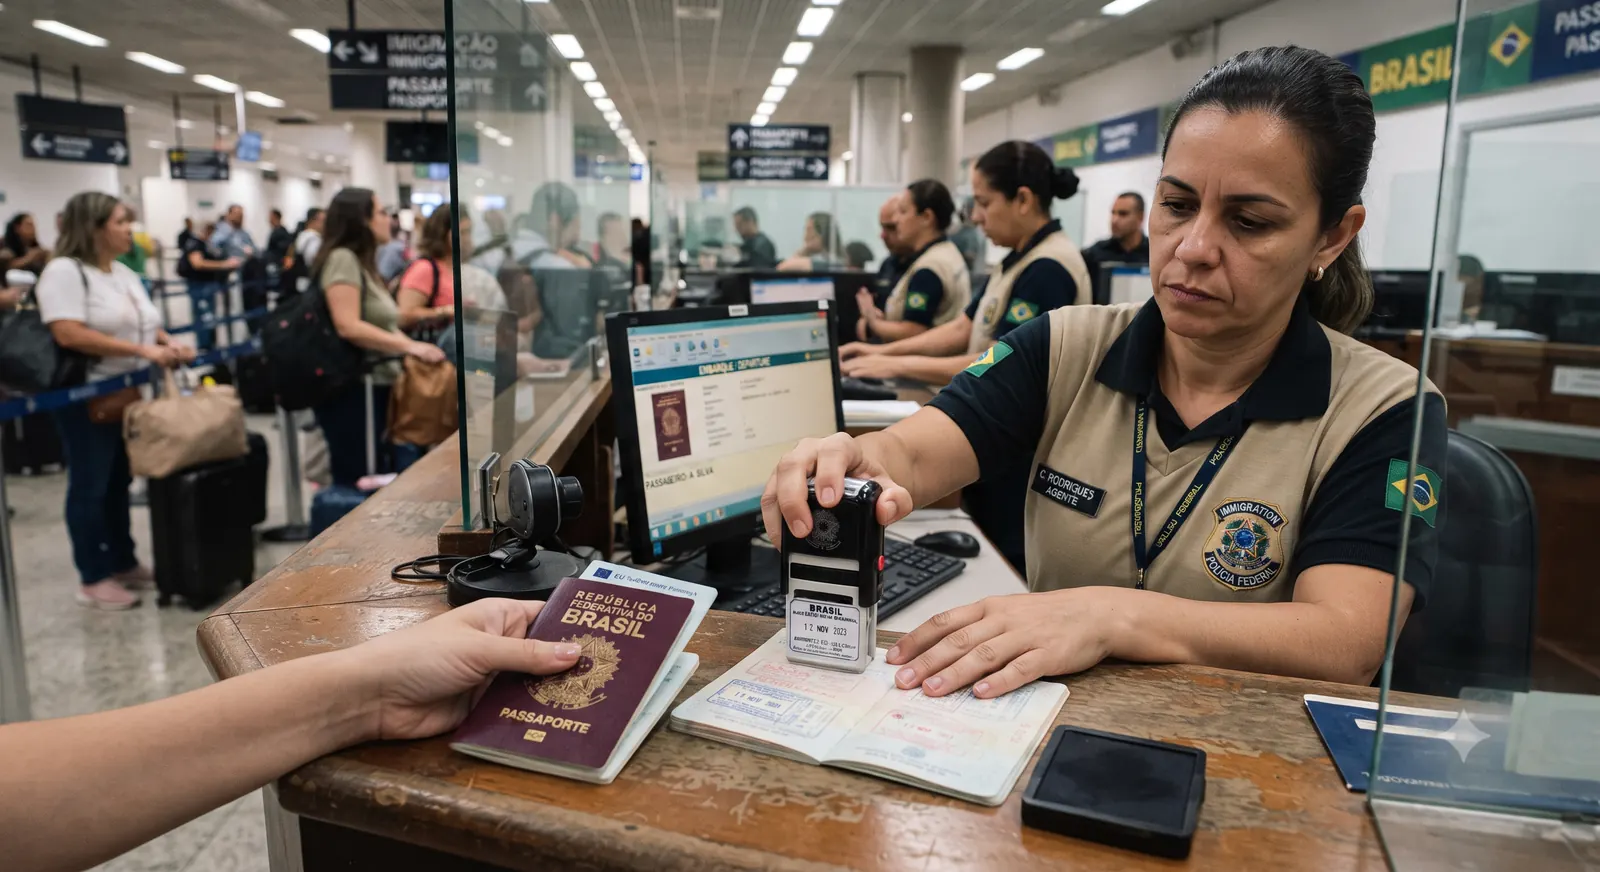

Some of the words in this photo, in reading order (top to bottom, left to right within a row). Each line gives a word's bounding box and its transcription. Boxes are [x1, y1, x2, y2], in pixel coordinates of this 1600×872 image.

[1369, 45, 1453, 95] BRASIL
[1045, 486, 1079, 507] AGENTE
[1047, 472, 1095, 501] RODRIGUES
[1219, 502, 1281, 525] IMMIGRATION
[1237, 567, 1278, 586] FEDERAL
[569, 599, 634, 619] FEDERATIVA
[635, 611, 654, 622] DO
[575, 590, 657, 614] REPÚBLICA
[809, 603, 843, 616] BRASIL
[560, 607, 645, 639] BRASIL
[816, 625, 829, 634] NOV
[833, 627, 848, 636] 2023
[499, 707, 592, 734] PASSAPORTE
